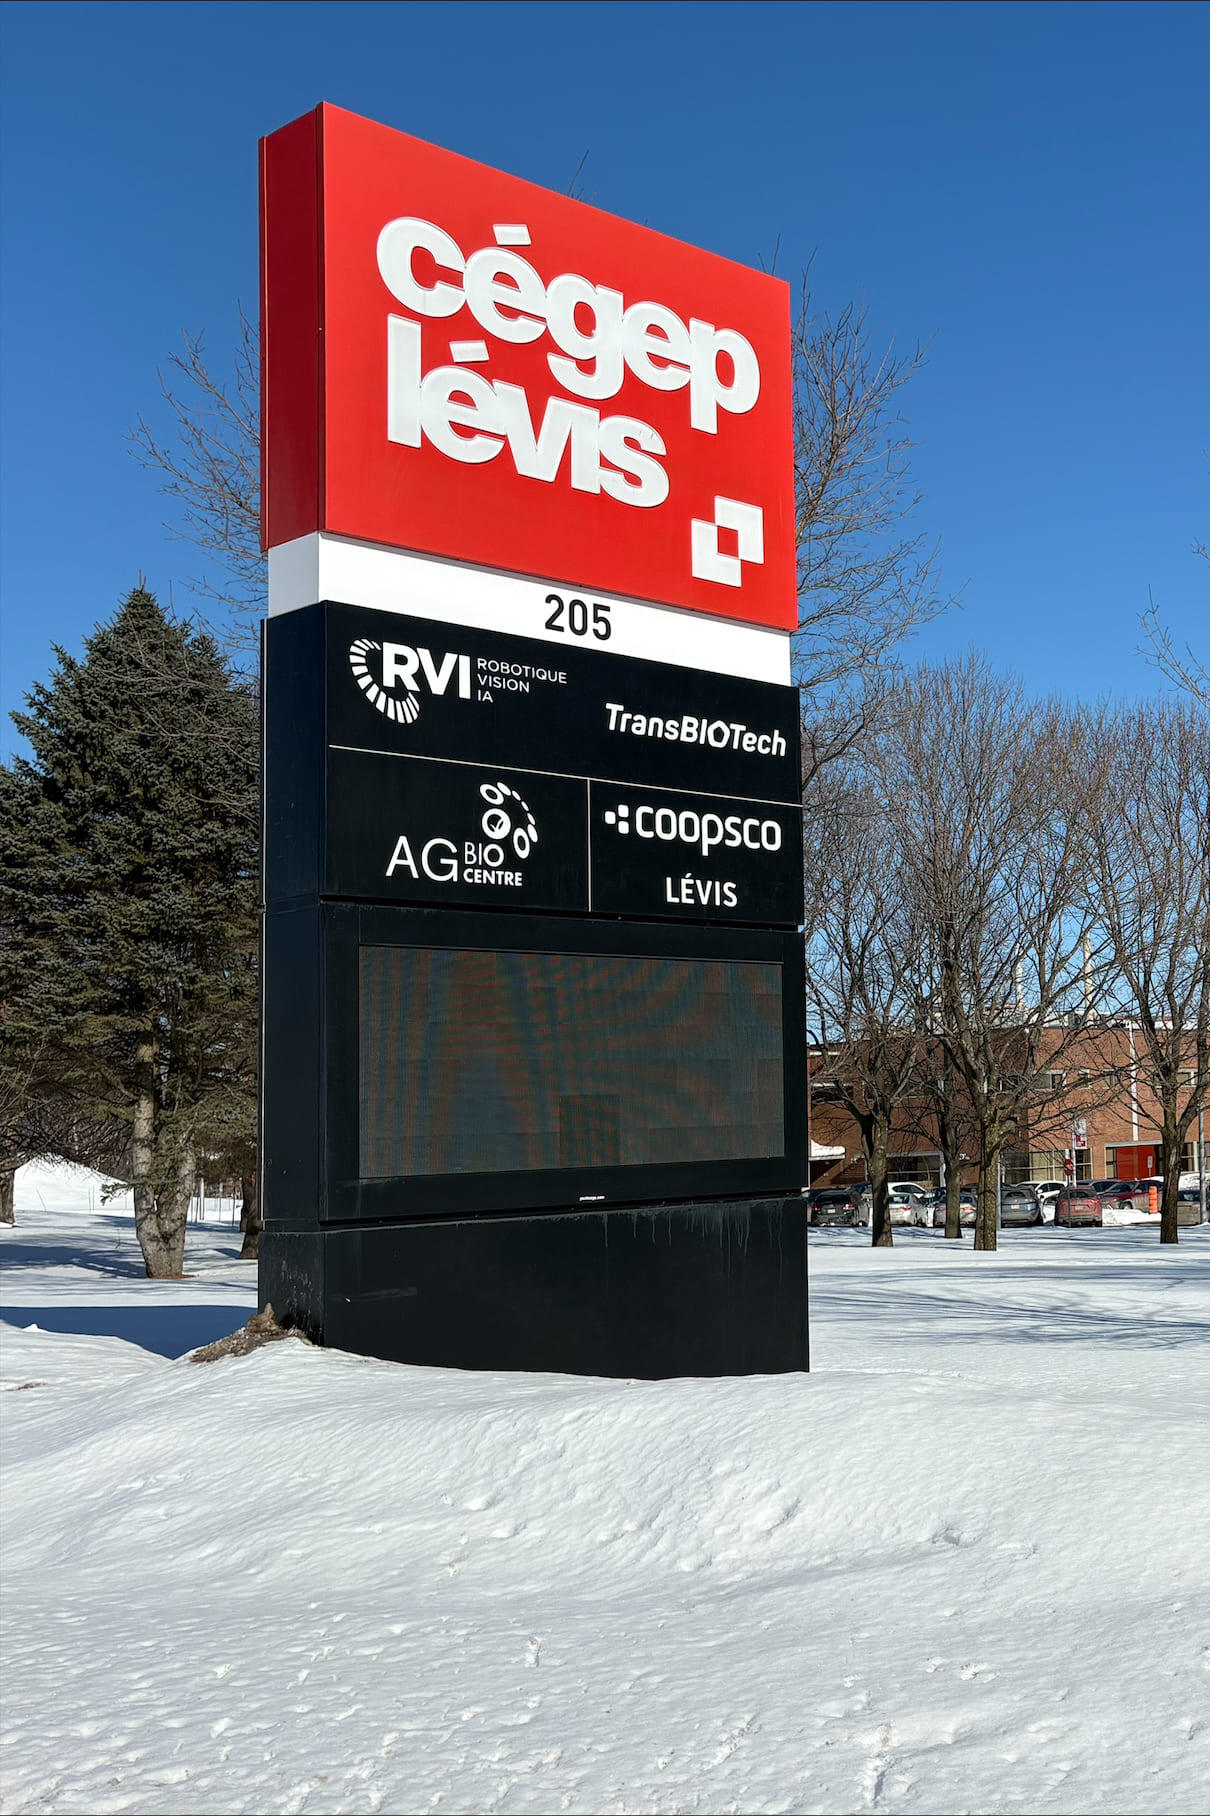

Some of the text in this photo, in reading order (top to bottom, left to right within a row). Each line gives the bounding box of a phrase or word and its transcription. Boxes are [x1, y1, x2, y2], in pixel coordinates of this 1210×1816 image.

[376, 216, 760, 434] cégep
[387, 314, 669, 508] lévis
[544, 594, 612, 641] 205
[477, 657, 568, 684] ROBOTIQUE
[477, 673, 530, 693] VISION
[477, 689, 494, 703] IA
[605, 702, 787, 757] TransBIOTech
[463, 867, 523, 886] CENTRE
[666, 872, 738, 908] LÉVIS
